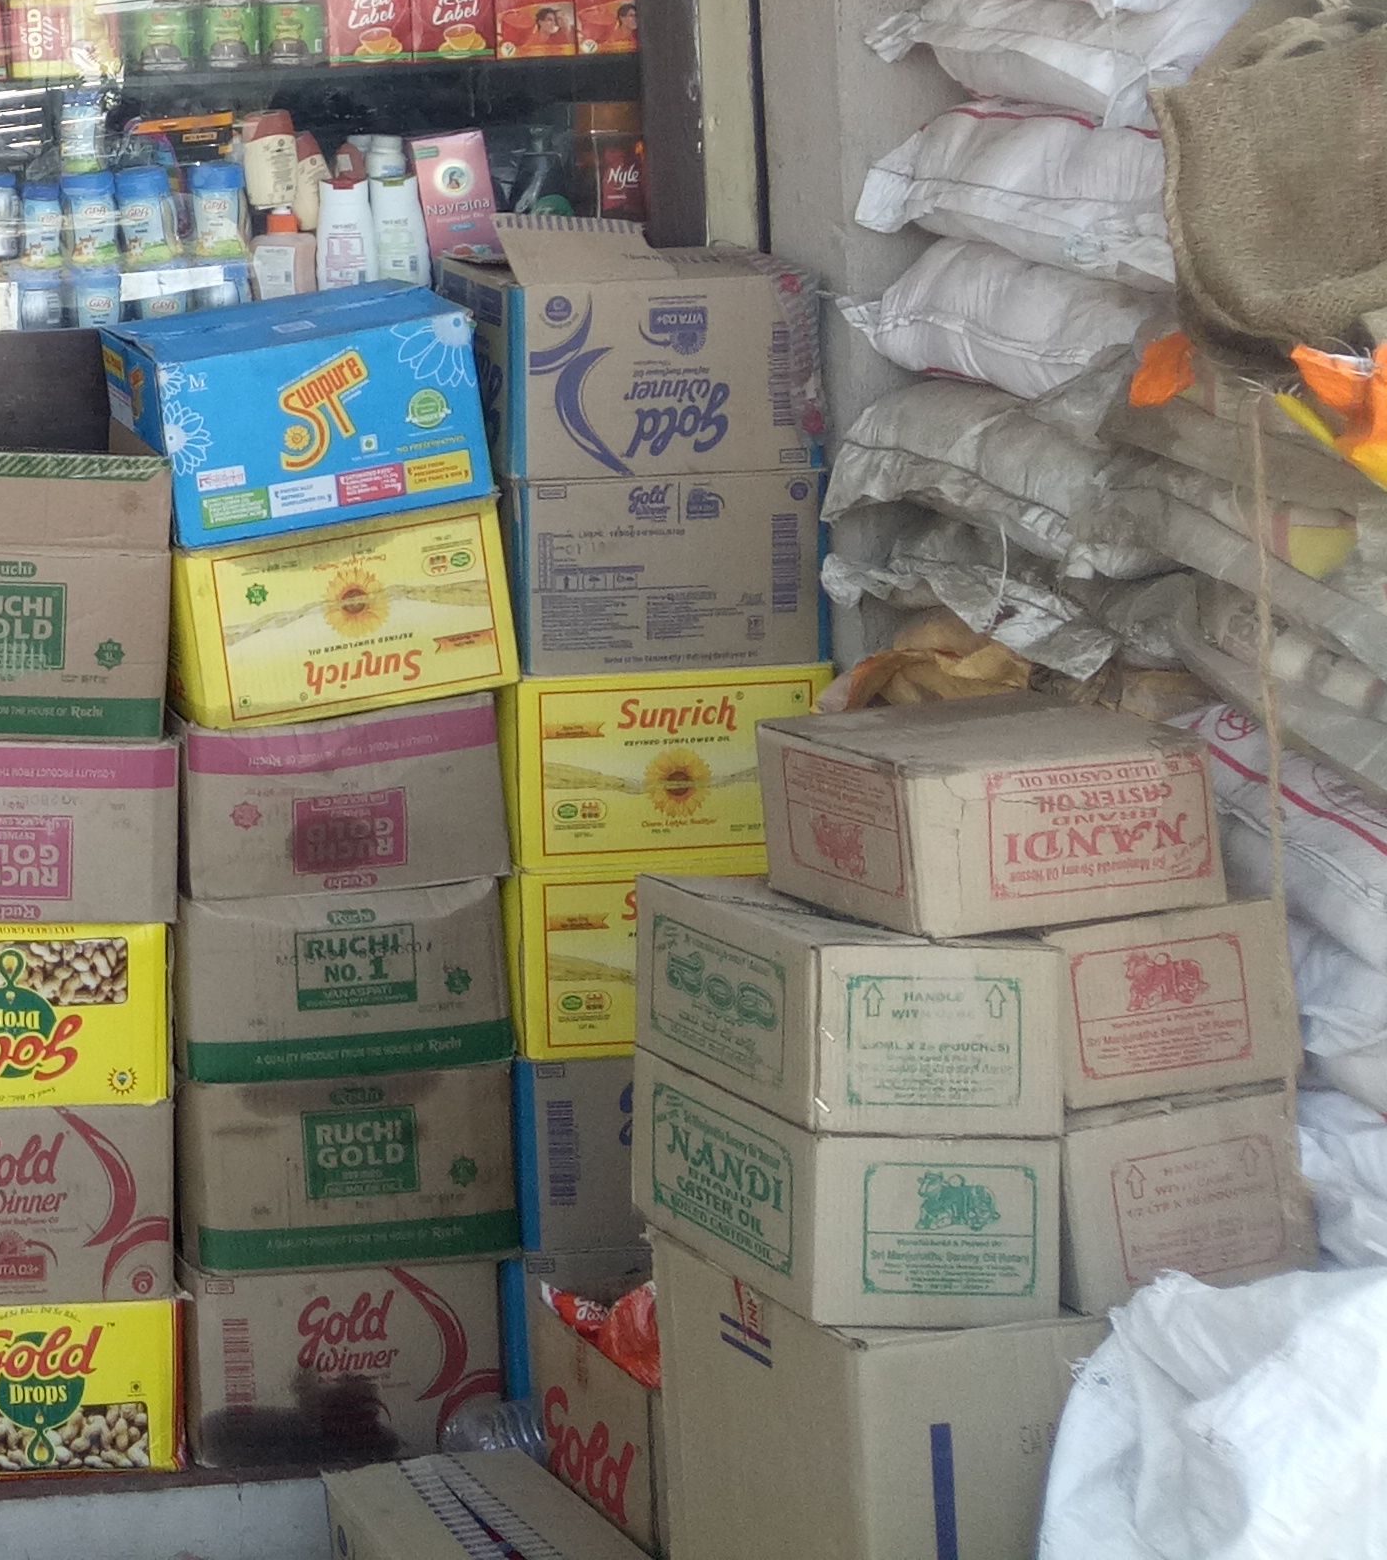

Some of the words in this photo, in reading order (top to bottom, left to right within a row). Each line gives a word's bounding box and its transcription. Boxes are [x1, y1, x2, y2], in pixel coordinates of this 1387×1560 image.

[29, 9, 42, 59] GOLD
[607, 165, 640, 187] Nyle
[303, 649, 423, 695] Sunrich
[618, 696, 737, 734] Sunrich
[1016, 777, 1043, 789] OIL
[1047, 769, 1113, 786] CASTOR
[1052, 808, 1158, 826] BRAND
[1003, 812, 1188, 866] NANDI
[330, 909, 373, 925] Ruchi
[304, 932, 400, 960] RUCHI
[324, 963, 363, 983] NO.
[368, 956, 389, 981] 1
[315, 1121, 403, 1145] RUCHI
[317, 1143, 405, 1169] GOLD
[667, 1124, 784, 1213] NANDI
[9, 1383, 67, 1405] Drops
